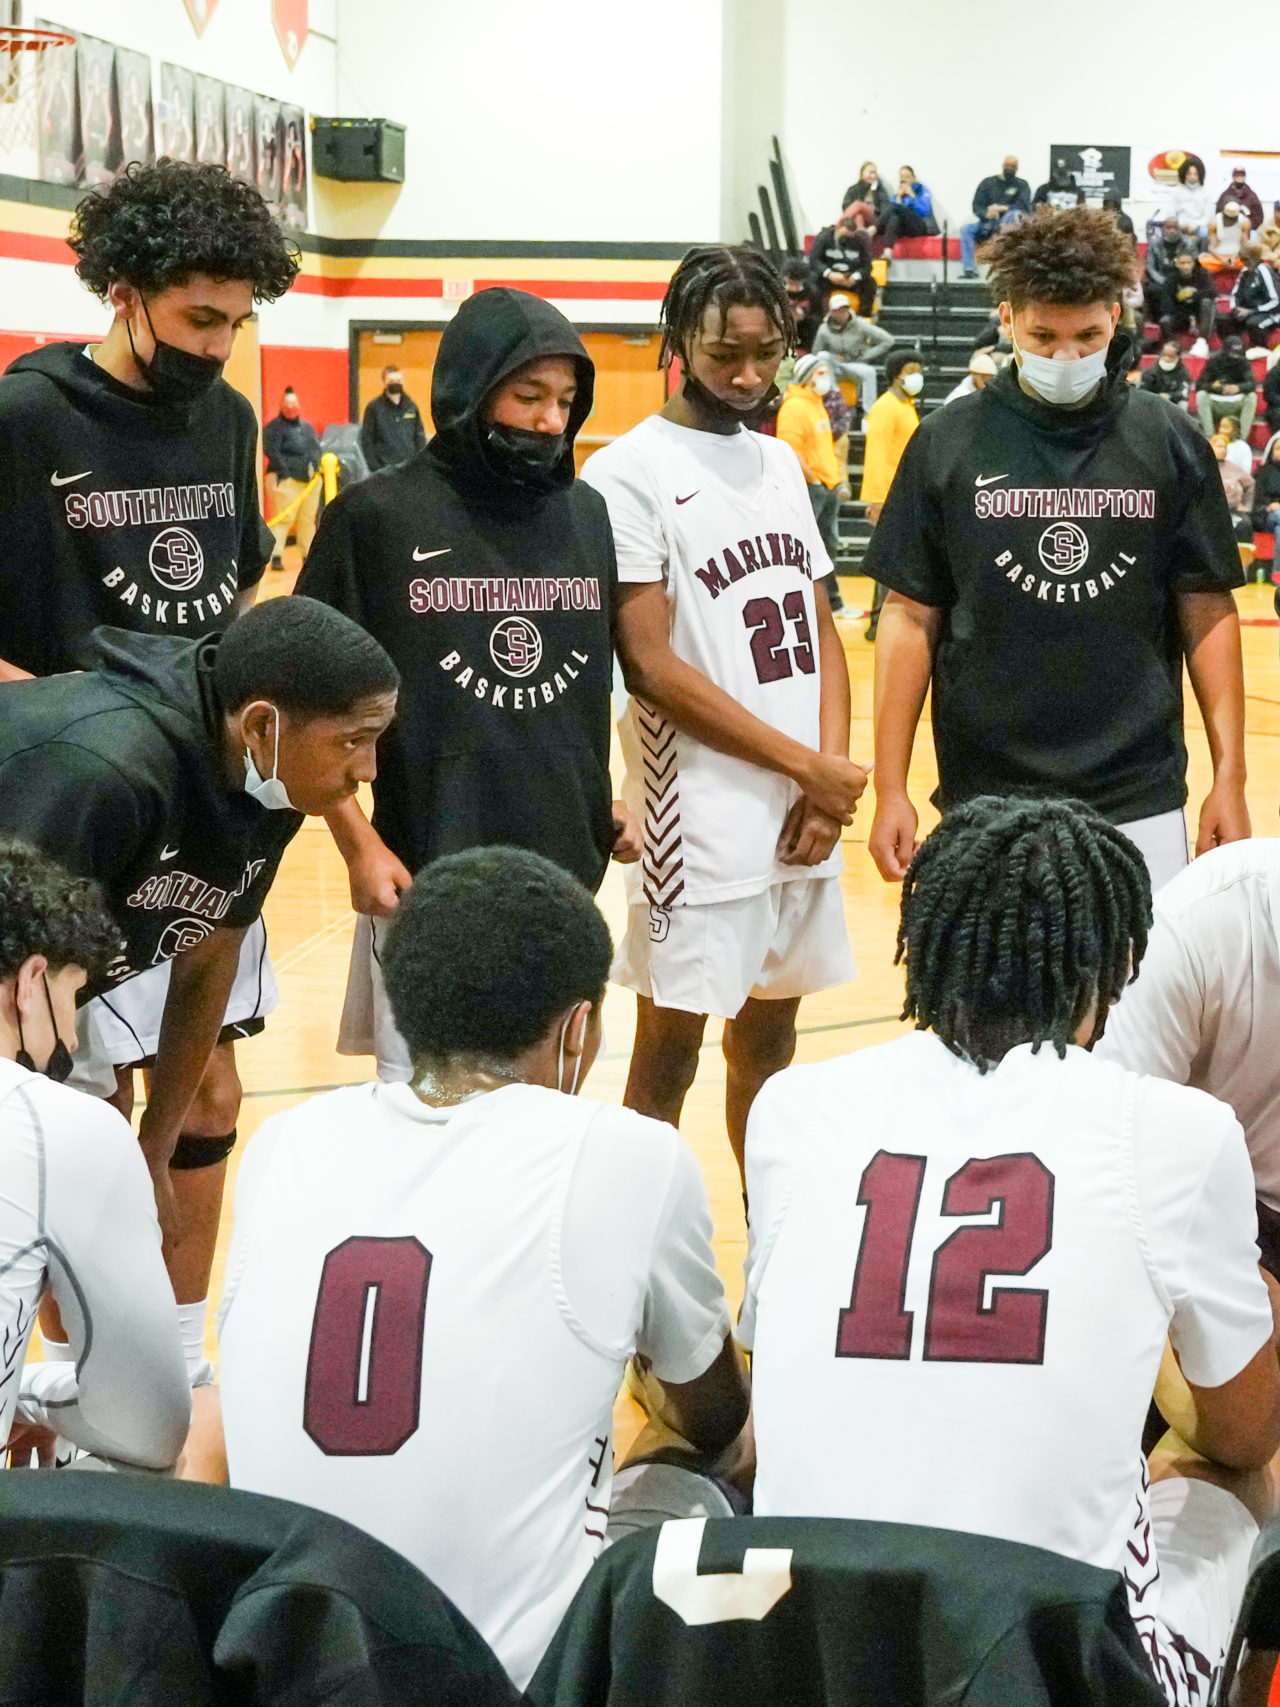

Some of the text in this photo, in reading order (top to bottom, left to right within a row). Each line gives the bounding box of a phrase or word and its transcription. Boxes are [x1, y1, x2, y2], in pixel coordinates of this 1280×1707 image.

[974, 487, 1156, 519] SOUTHAMPTON
[166, 537, 191, 580] S
[694, 532, 813, 600] MARINERS
[1053, 530, 1074, 566] S
[409, 577, 601, 613] SOUTHAMPTON
[994, 549, 1137, 603] BASKETBALL
[506, 627, 529, 667] S
[742, 589, 816, 685] 23
[439, 649, 589, 710] BASKETBALL
[835, 1148, 1056, 1366] 12
[302, 1235, 434, 1457] 0
